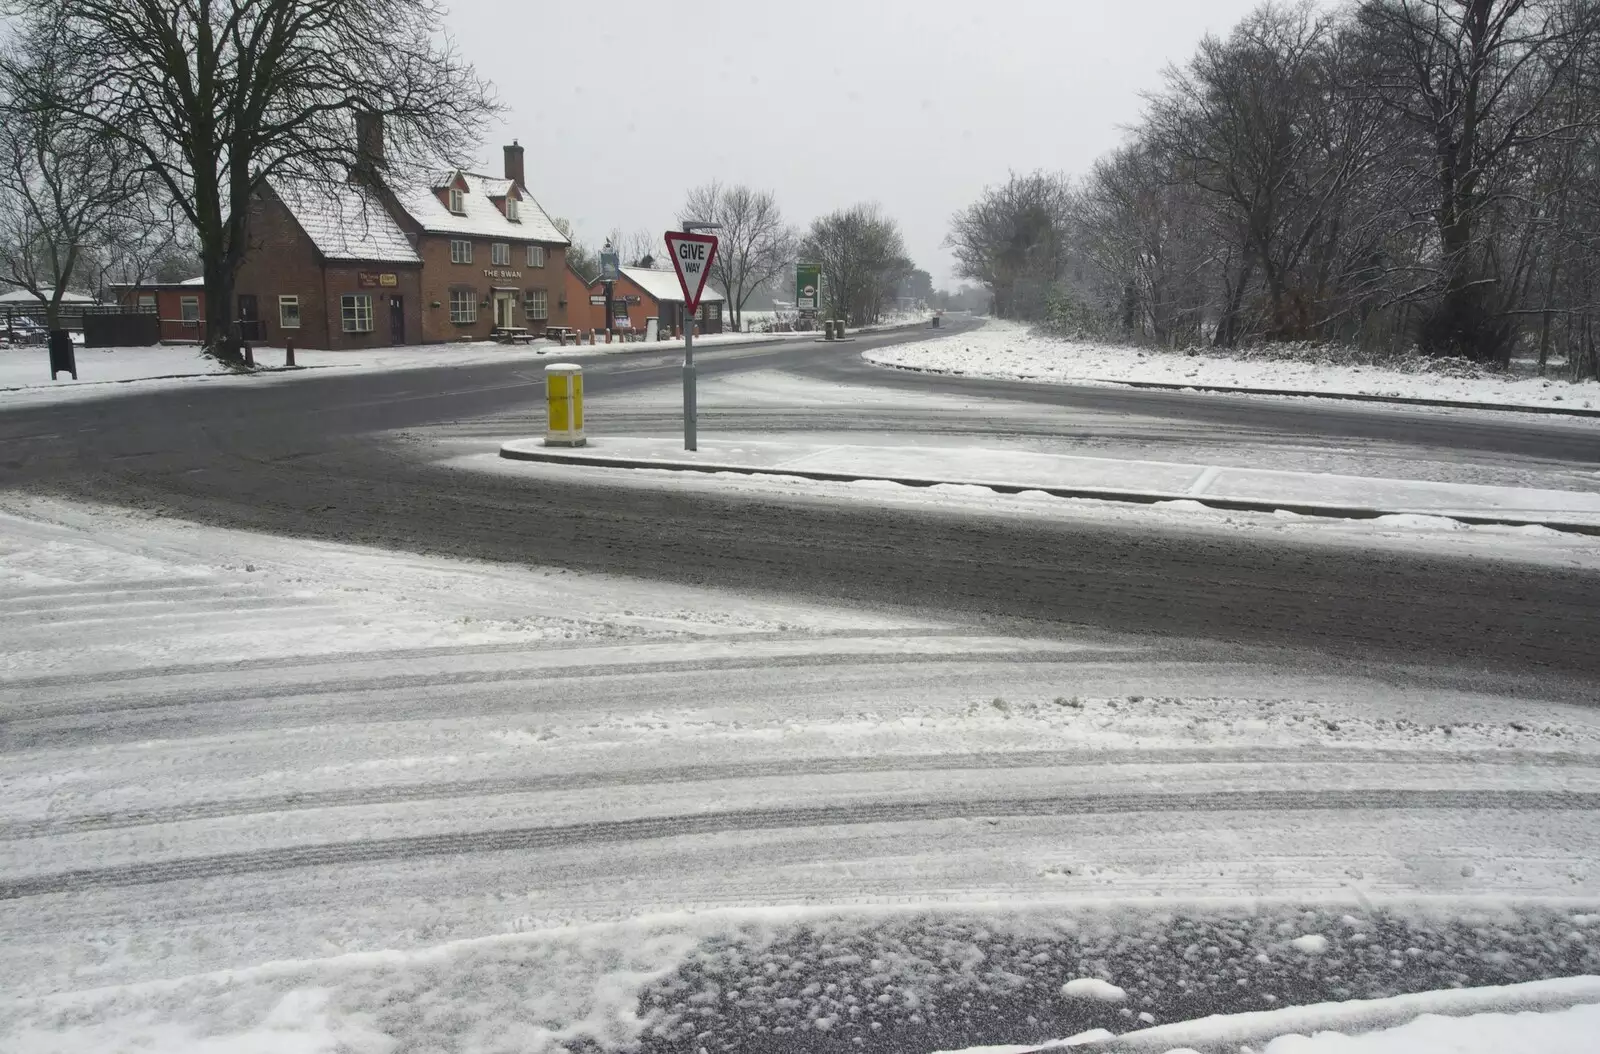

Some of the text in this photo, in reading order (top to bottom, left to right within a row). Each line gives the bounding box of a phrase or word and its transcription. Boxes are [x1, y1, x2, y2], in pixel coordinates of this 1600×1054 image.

[680, 244, 705, 260] GIVE
[685, 262, 700, 273] WAY
[501, 270, 522, 278] SWAN
